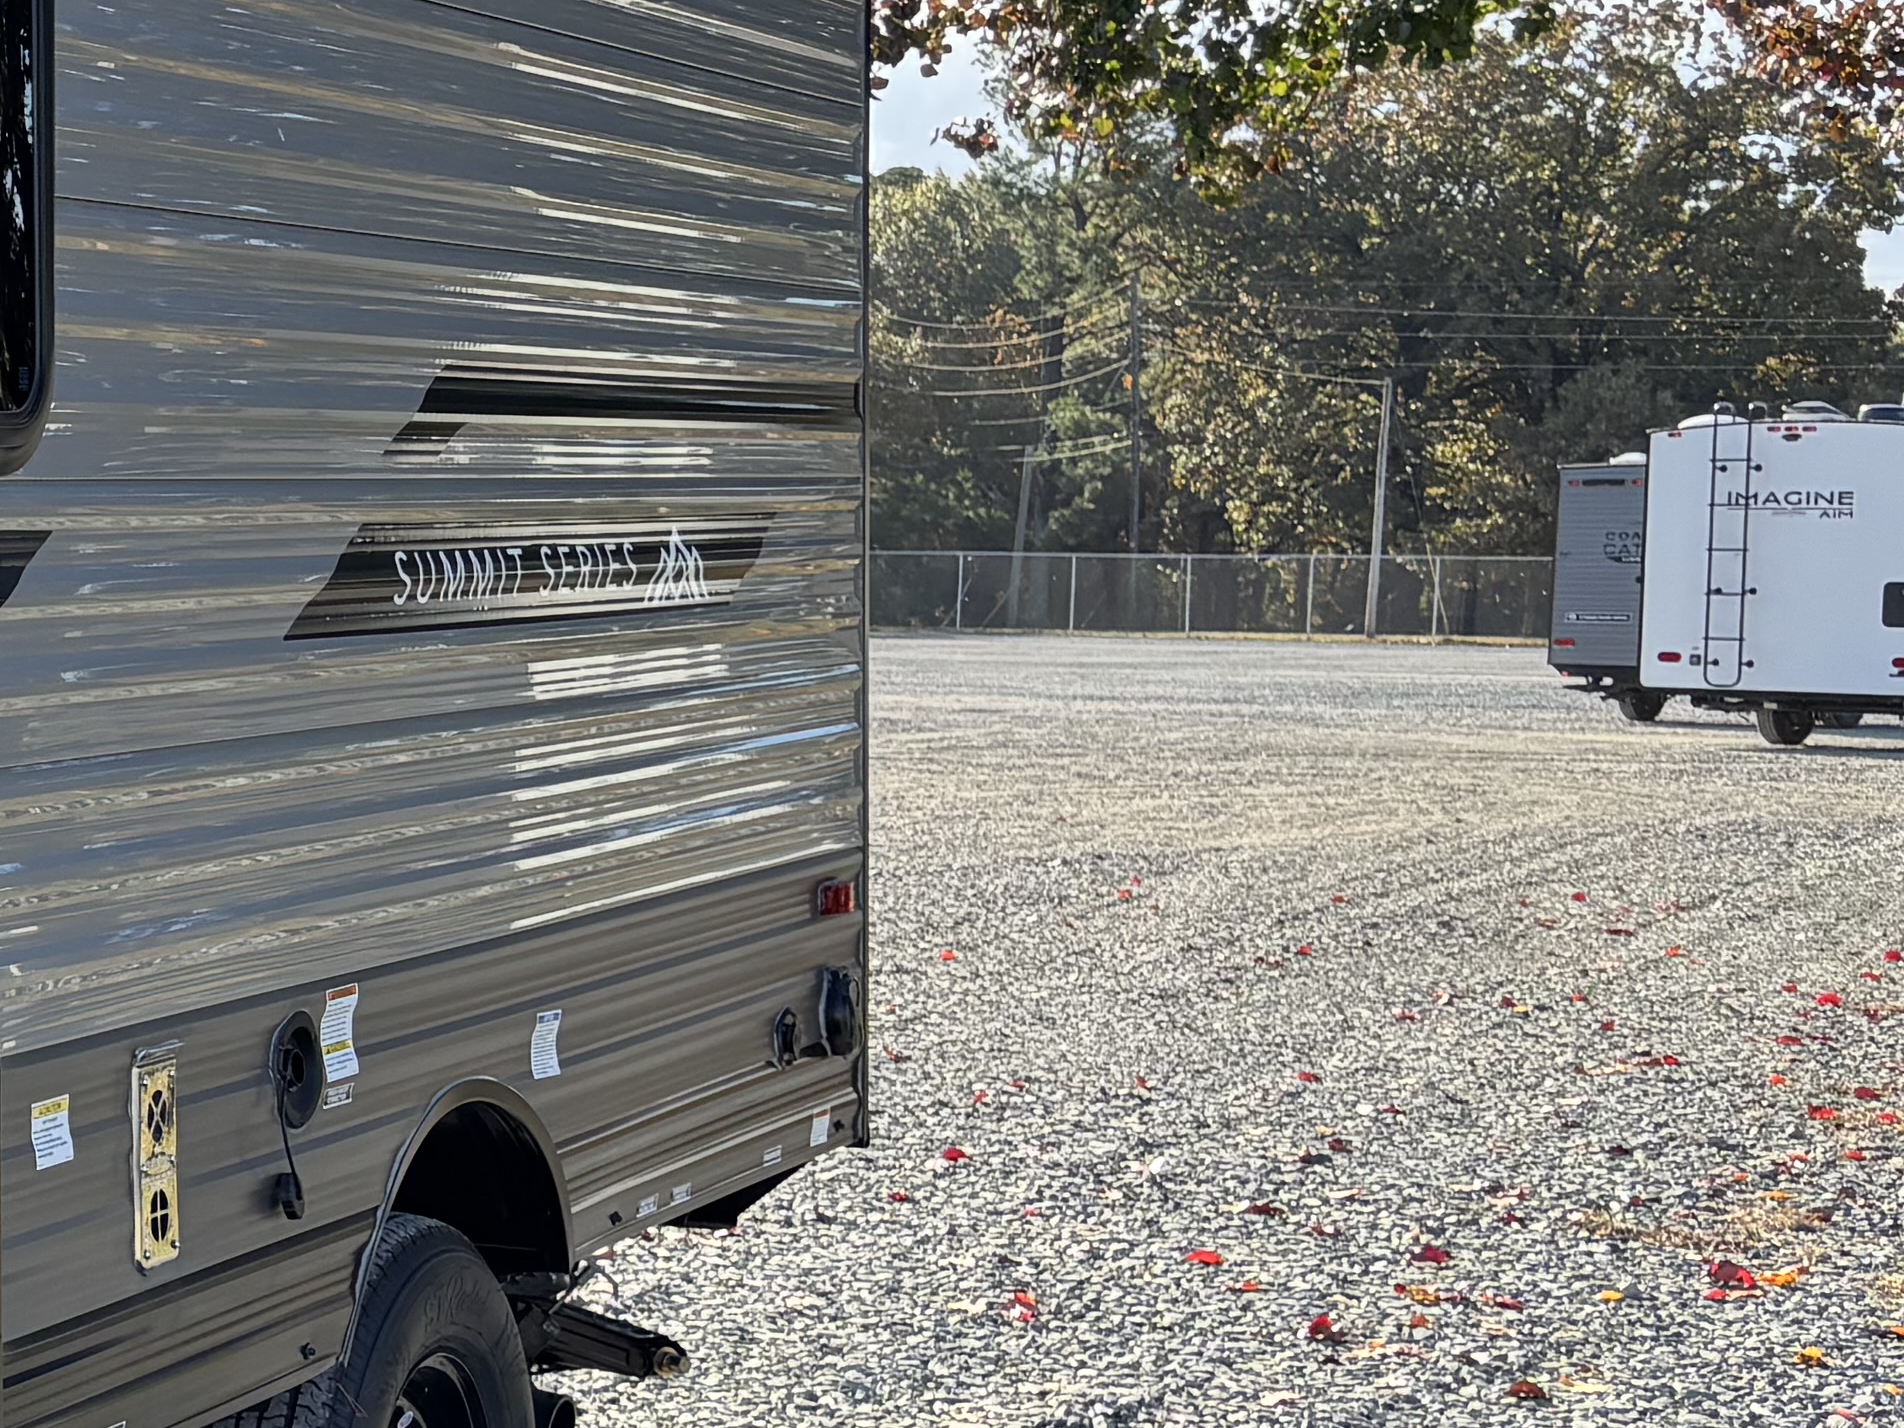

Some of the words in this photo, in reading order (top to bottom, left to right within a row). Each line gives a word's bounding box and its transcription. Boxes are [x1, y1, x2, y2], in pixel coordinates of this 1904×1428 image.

[1727, 490, 1855, 506] IMAGINE
[391, 548, 524, 606] SUMMIT
[538, 543, 638, 598] SERIES
